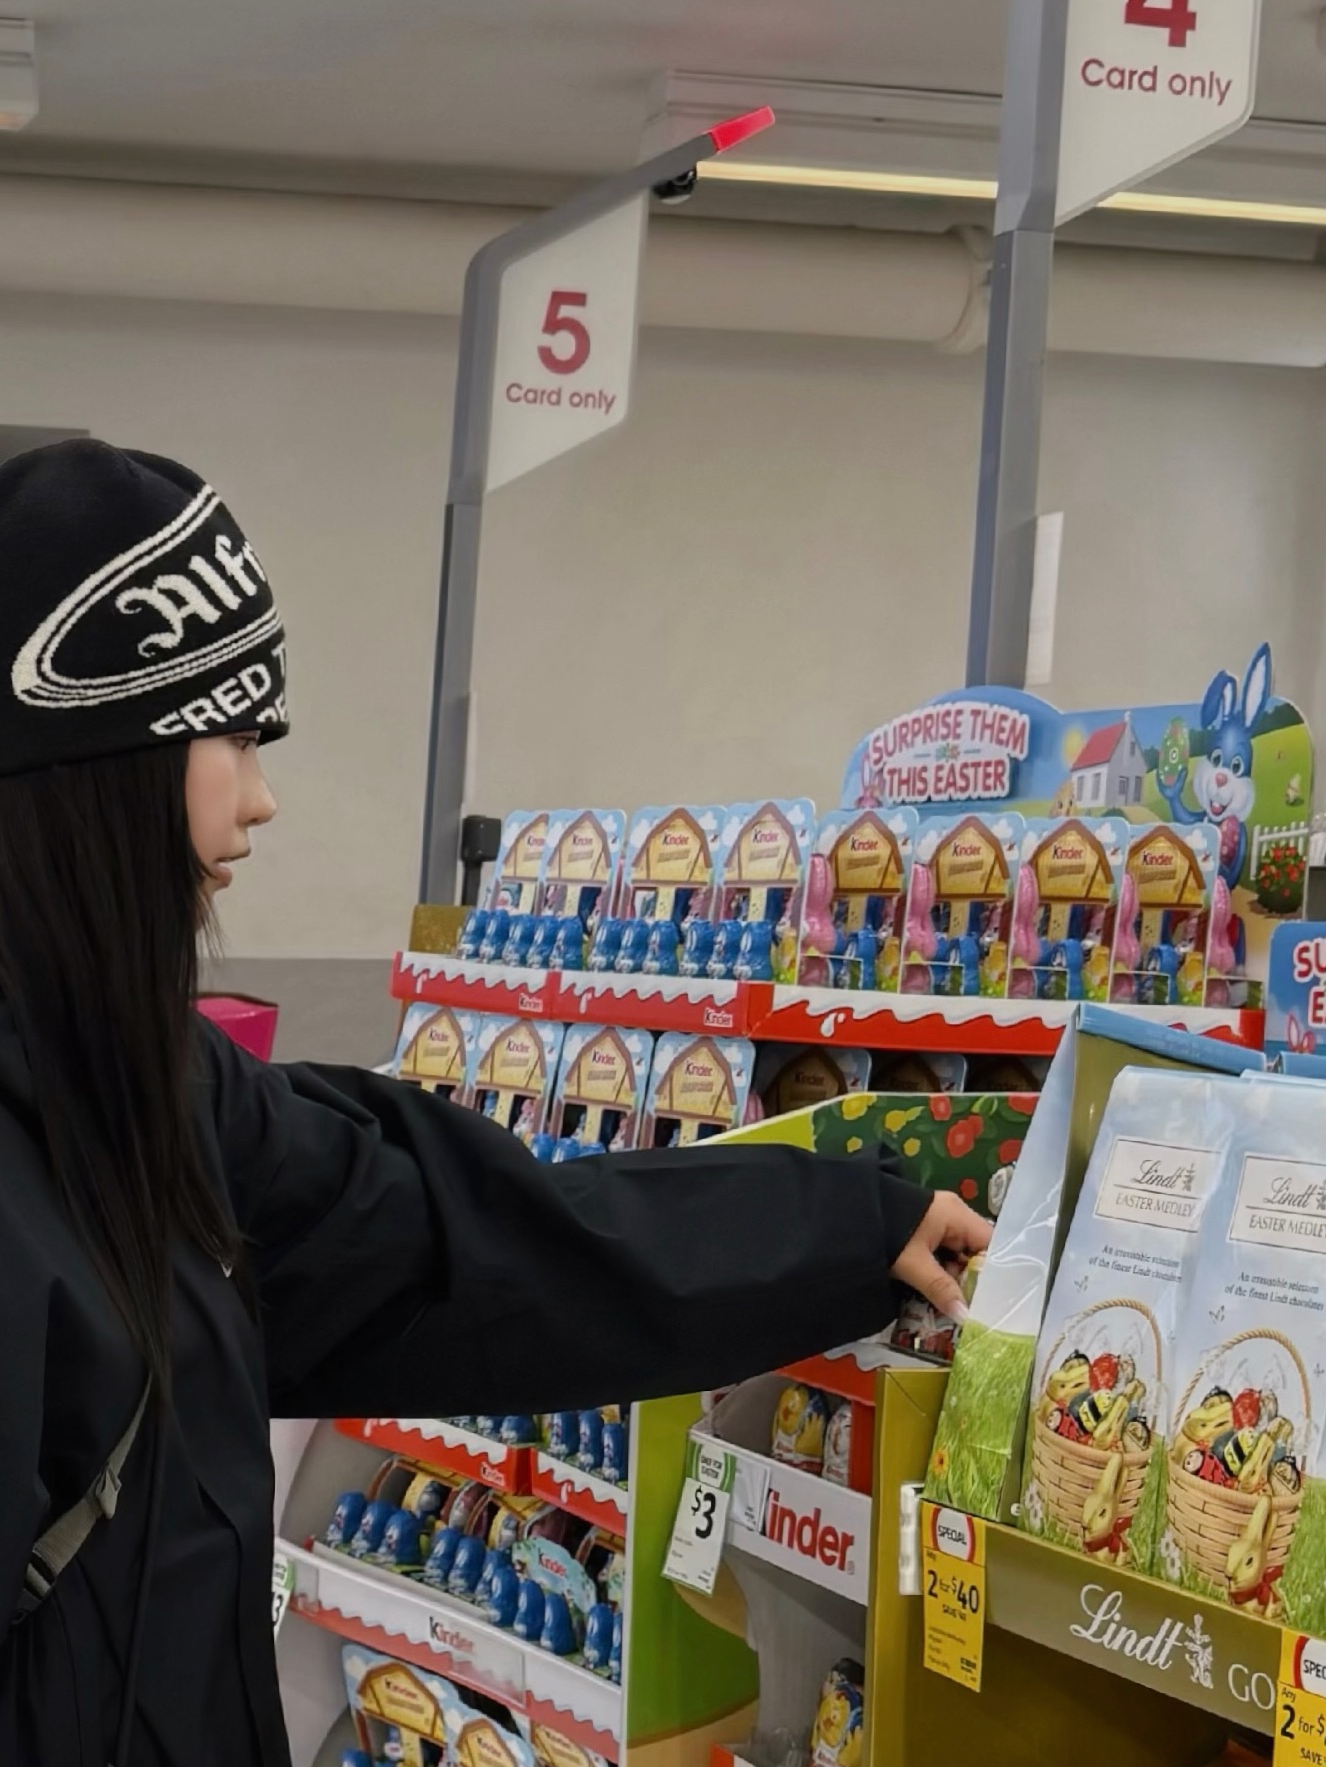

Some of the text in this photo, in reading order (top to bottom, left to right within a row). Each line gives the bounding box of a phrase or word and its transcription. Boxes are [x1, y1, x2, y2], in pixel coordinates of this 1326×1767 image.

[1081, 58, 1232, 106] Card only
[537, 290, 591, 375] 5
[505, 382, 616, 414] Card only
[872, 709, 1027, 766] SURPRISE THEM
[887, 759, 1006, 797] THIS EASTER
[1131, 1159, 1183, 1189] Lindt
[1116, 1192, 1195, 1218] EASTER MEDLEY
[1263, 1177, 1317, 1209] Lindt
[1249, 1215, 1286, 1232] EASTER
[691, 1485, 716, 1540] $3
[760, 1489, 855, 1571] inder
[938, 1524, 967, 1547] SPECIAL
[927, 1569, 939, 1600] 2
[951, 1575, 979, 1614] $40
[1070, 1583, 1185, 1671] Lindt
[1280, 1704, 1296, 1740] 2
[1298, 1717, 1314, 1736] for
[1300, 1748, 1323, 1767] SAVE
